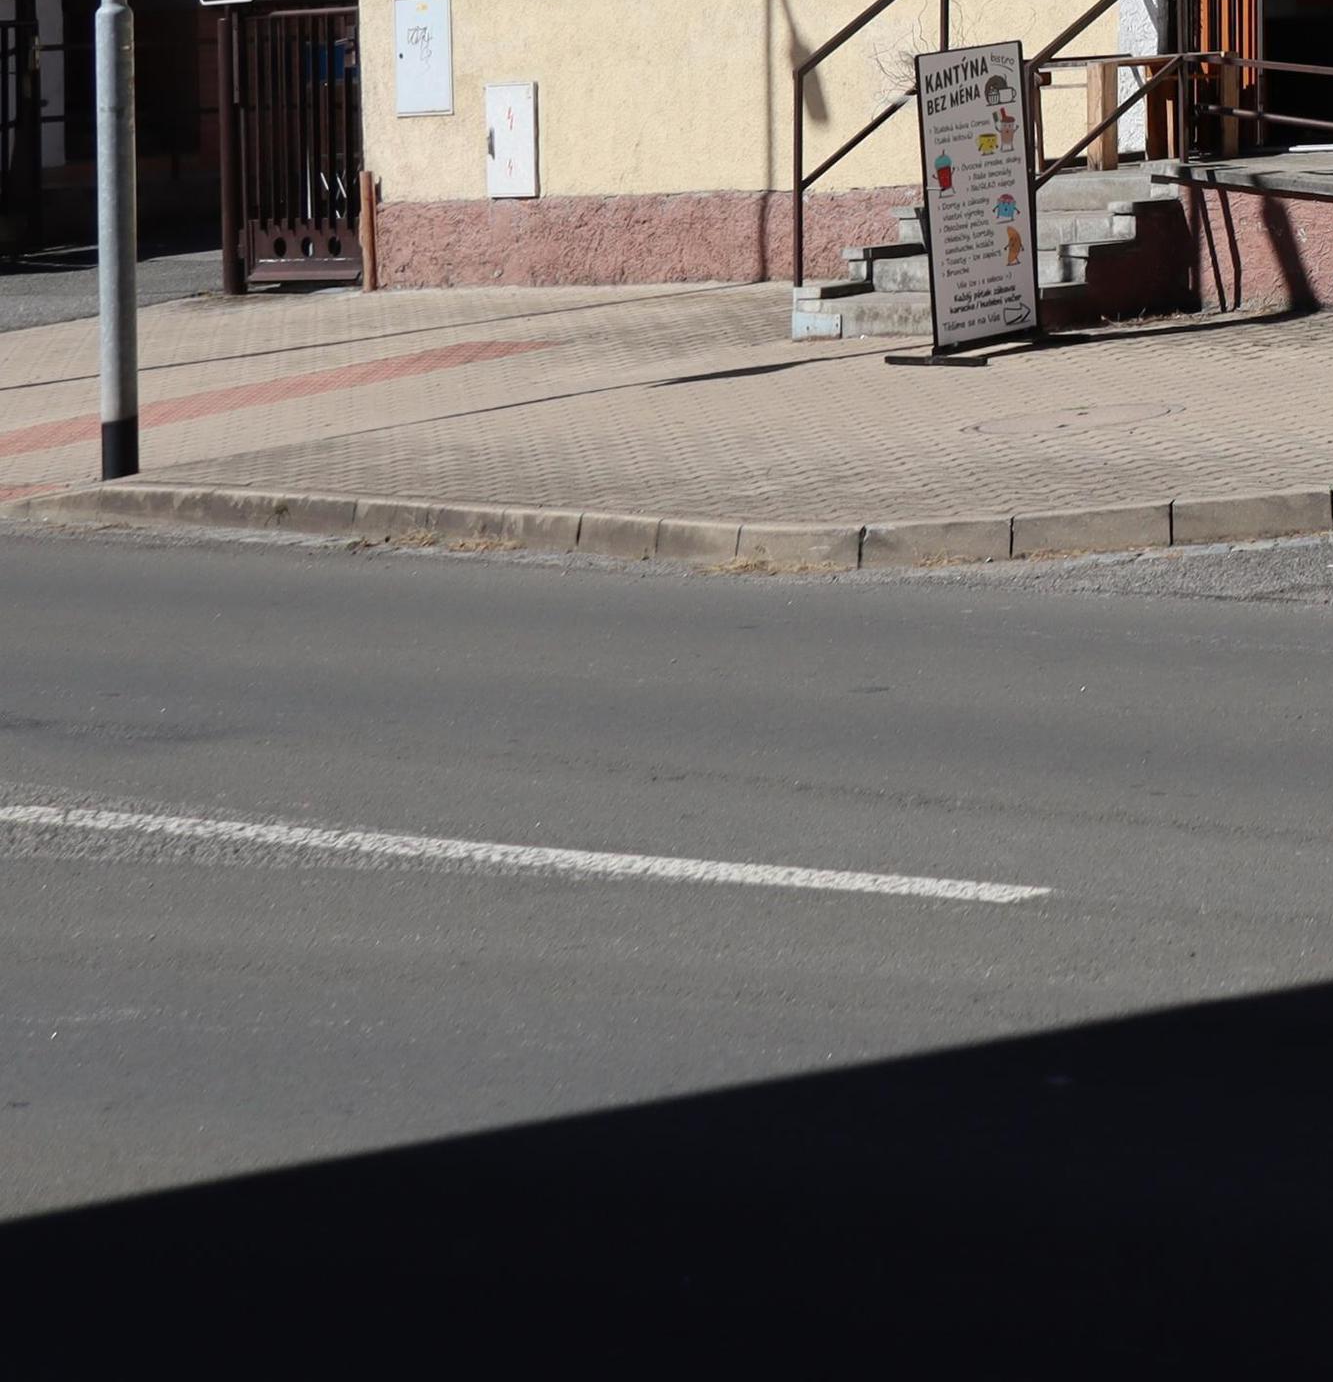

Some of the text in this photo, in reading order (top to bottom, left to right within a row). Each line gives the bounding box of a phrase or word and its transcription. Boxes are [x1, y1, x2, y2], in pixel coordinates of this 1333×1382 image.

[925, 56, 989, 94] KANTÝNA
[927, 83, 981, 116] BEZ MÉNA
